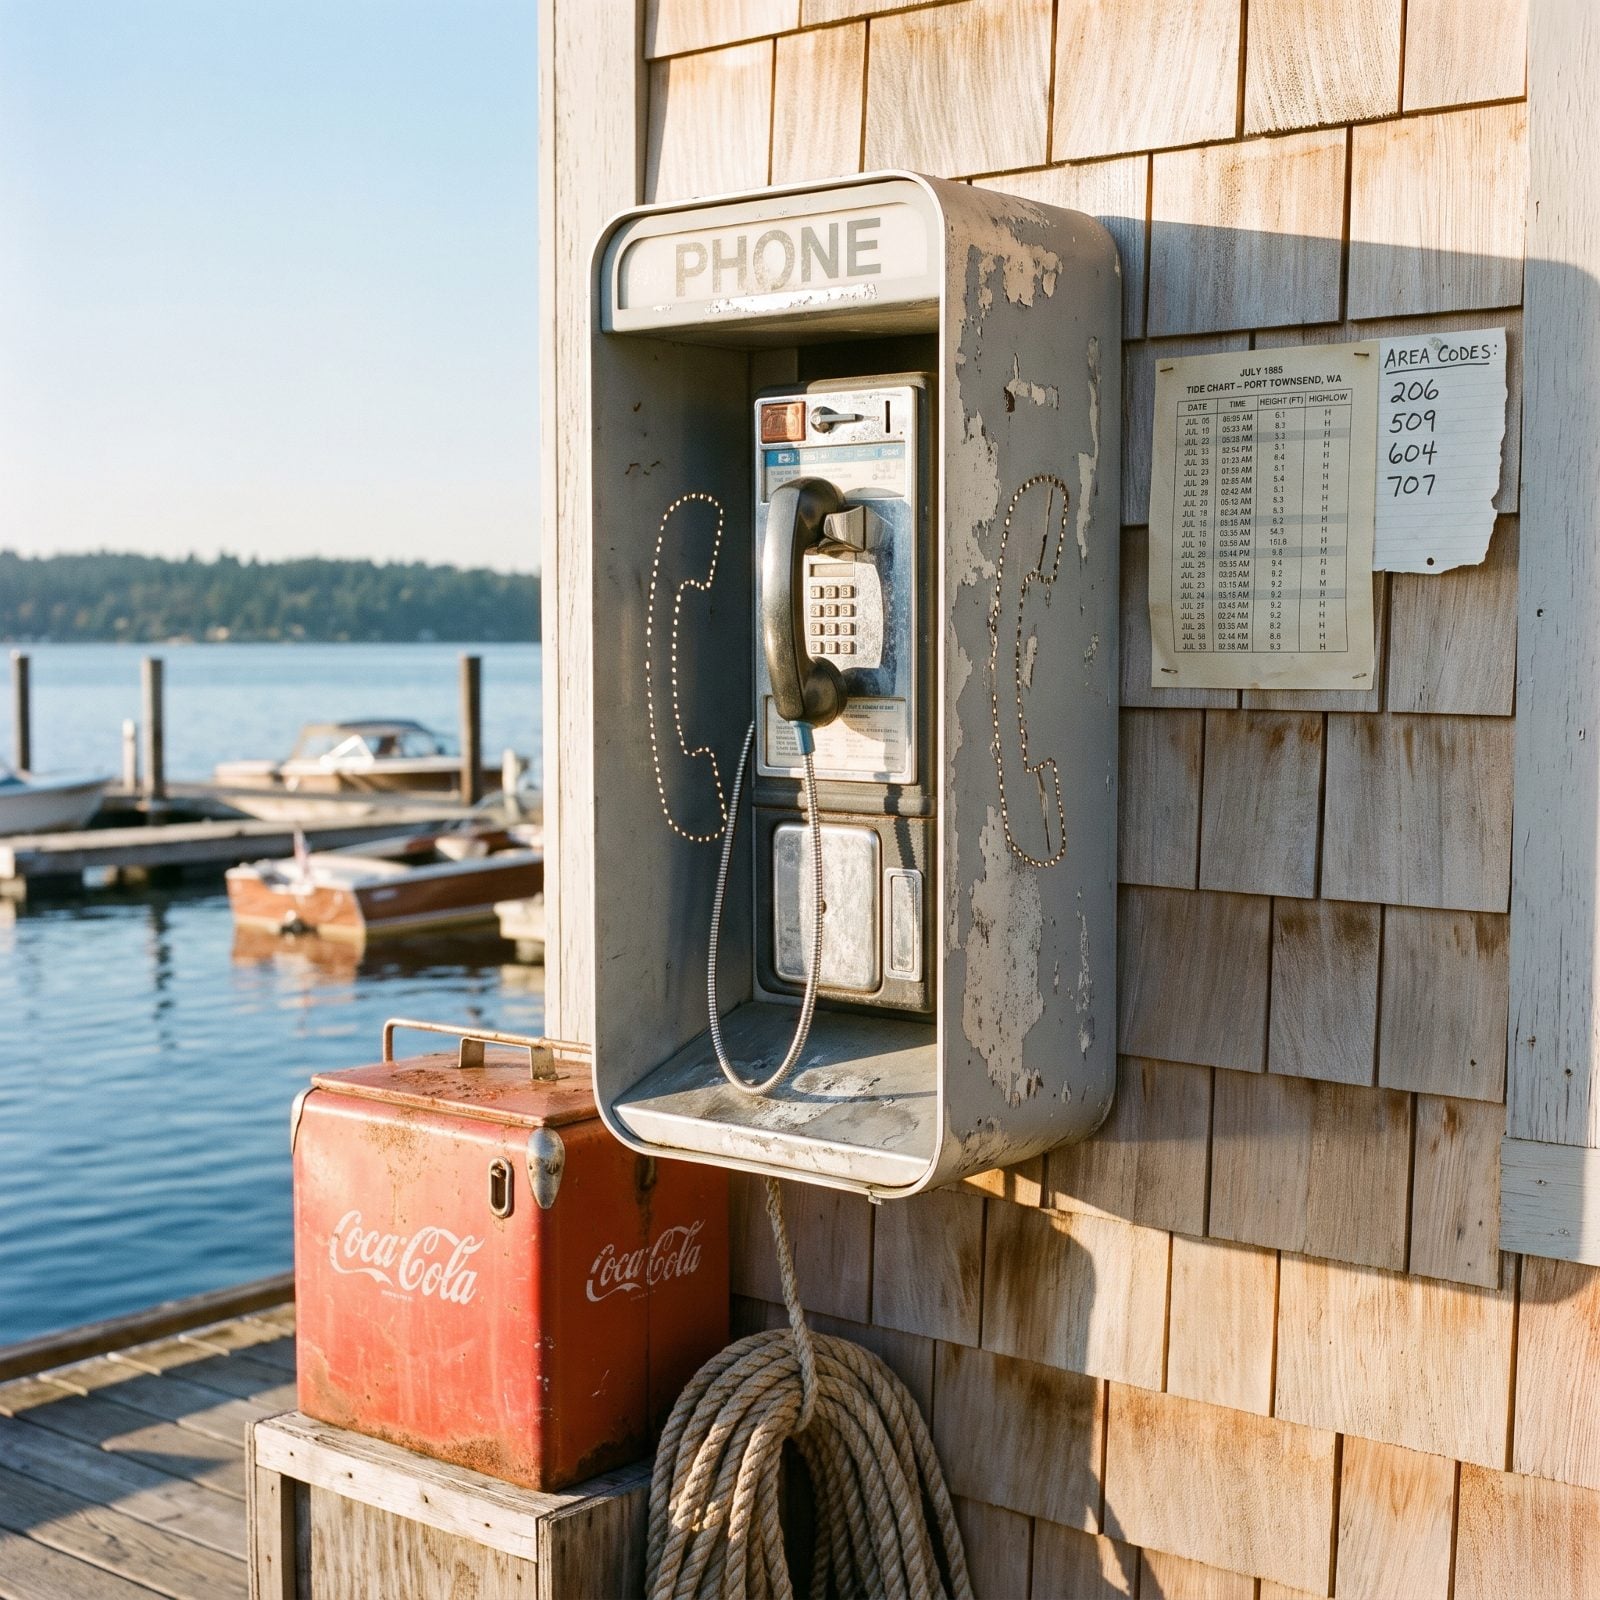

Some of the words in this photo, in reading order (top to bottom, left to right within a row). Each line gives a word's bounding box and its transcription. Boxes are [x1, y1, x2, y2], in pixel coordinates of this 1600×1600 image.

[676, 217, 882, 297] PHONE
[1384, 348, 1430, 368] AREA
[1437, 344, 1498, 363] CODES:
[1187, 385, 1205, 394] TIDE
[1207, 383, 1235, 392] CHART
[1244, 380, 1266, 388] PORT
[1270, 376, 1324, 387] TOWNSEND,
[1326, 375, 1341, 383] WA
[1240, 368, 1261, 377] JULY
[1230, 400, 1246, 408] TIME
[1260, 398, 1287, 406] HEIGHT
[1289, 396, 1304, 405] (FT)
[1391, 379, 1439, 403] 206
[1389, 409, 1436, 433] 509
[1388, 440, 1437, 465] 604
[1387, 474, 1436, 497] 707
[329, 1210, 485, 1304] Coca-Cola
[586, 1220, 706, 1302] Coca-Cola
